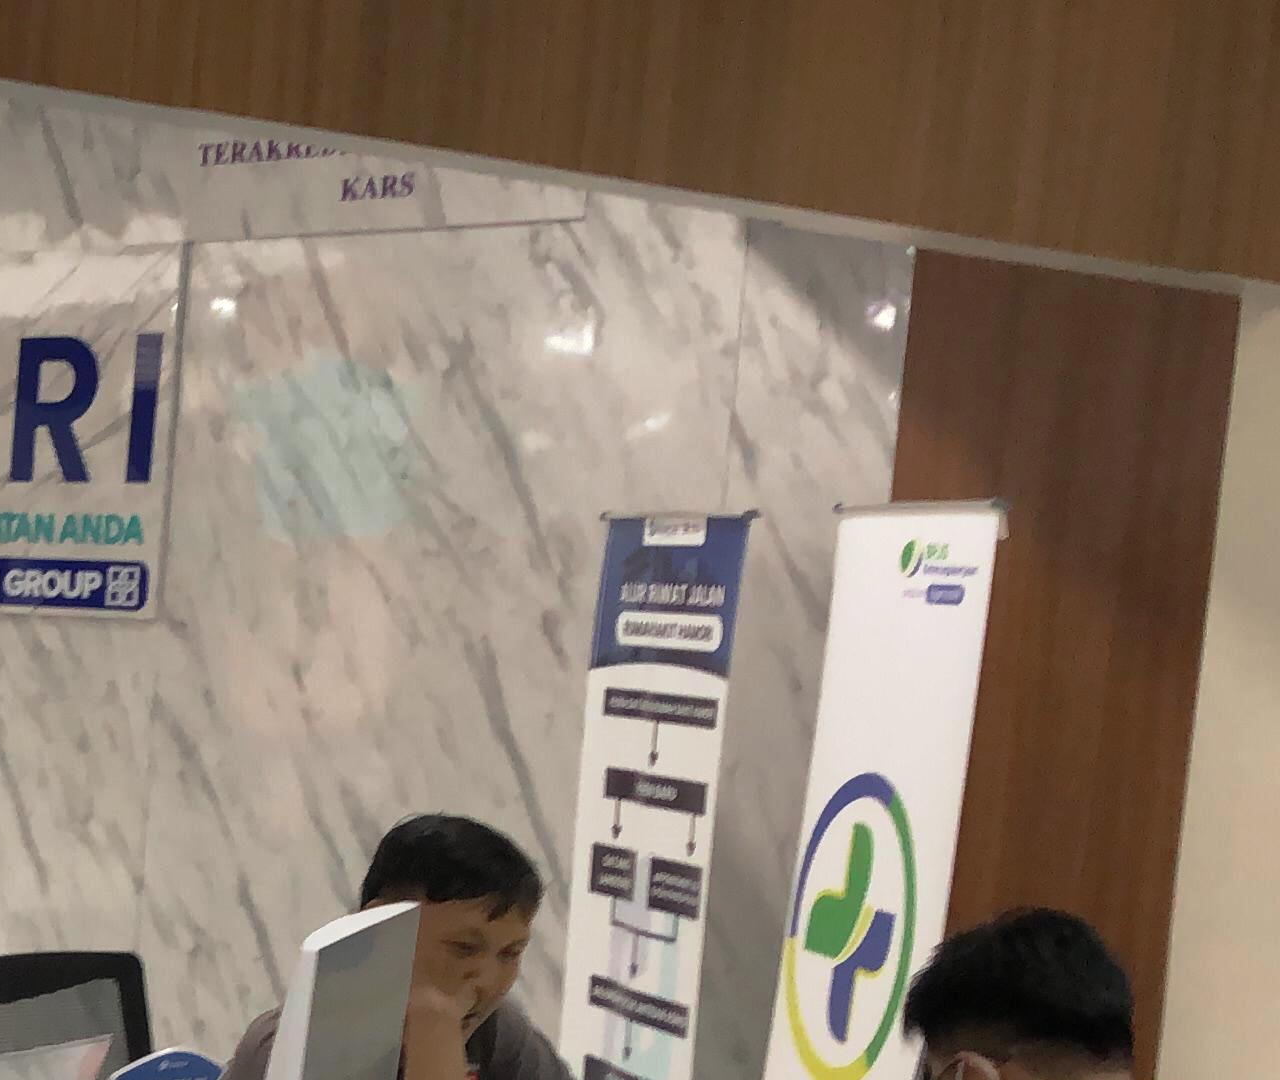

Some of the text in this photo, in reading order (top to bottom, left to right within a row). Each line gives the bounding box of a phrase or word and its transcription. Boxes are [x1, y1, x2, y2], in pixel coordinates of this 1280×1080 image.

[340, 172, 415, 202] KARS
[58, 514, 144, 545] ANDA
[3, 566, 103, 599] GROUP
